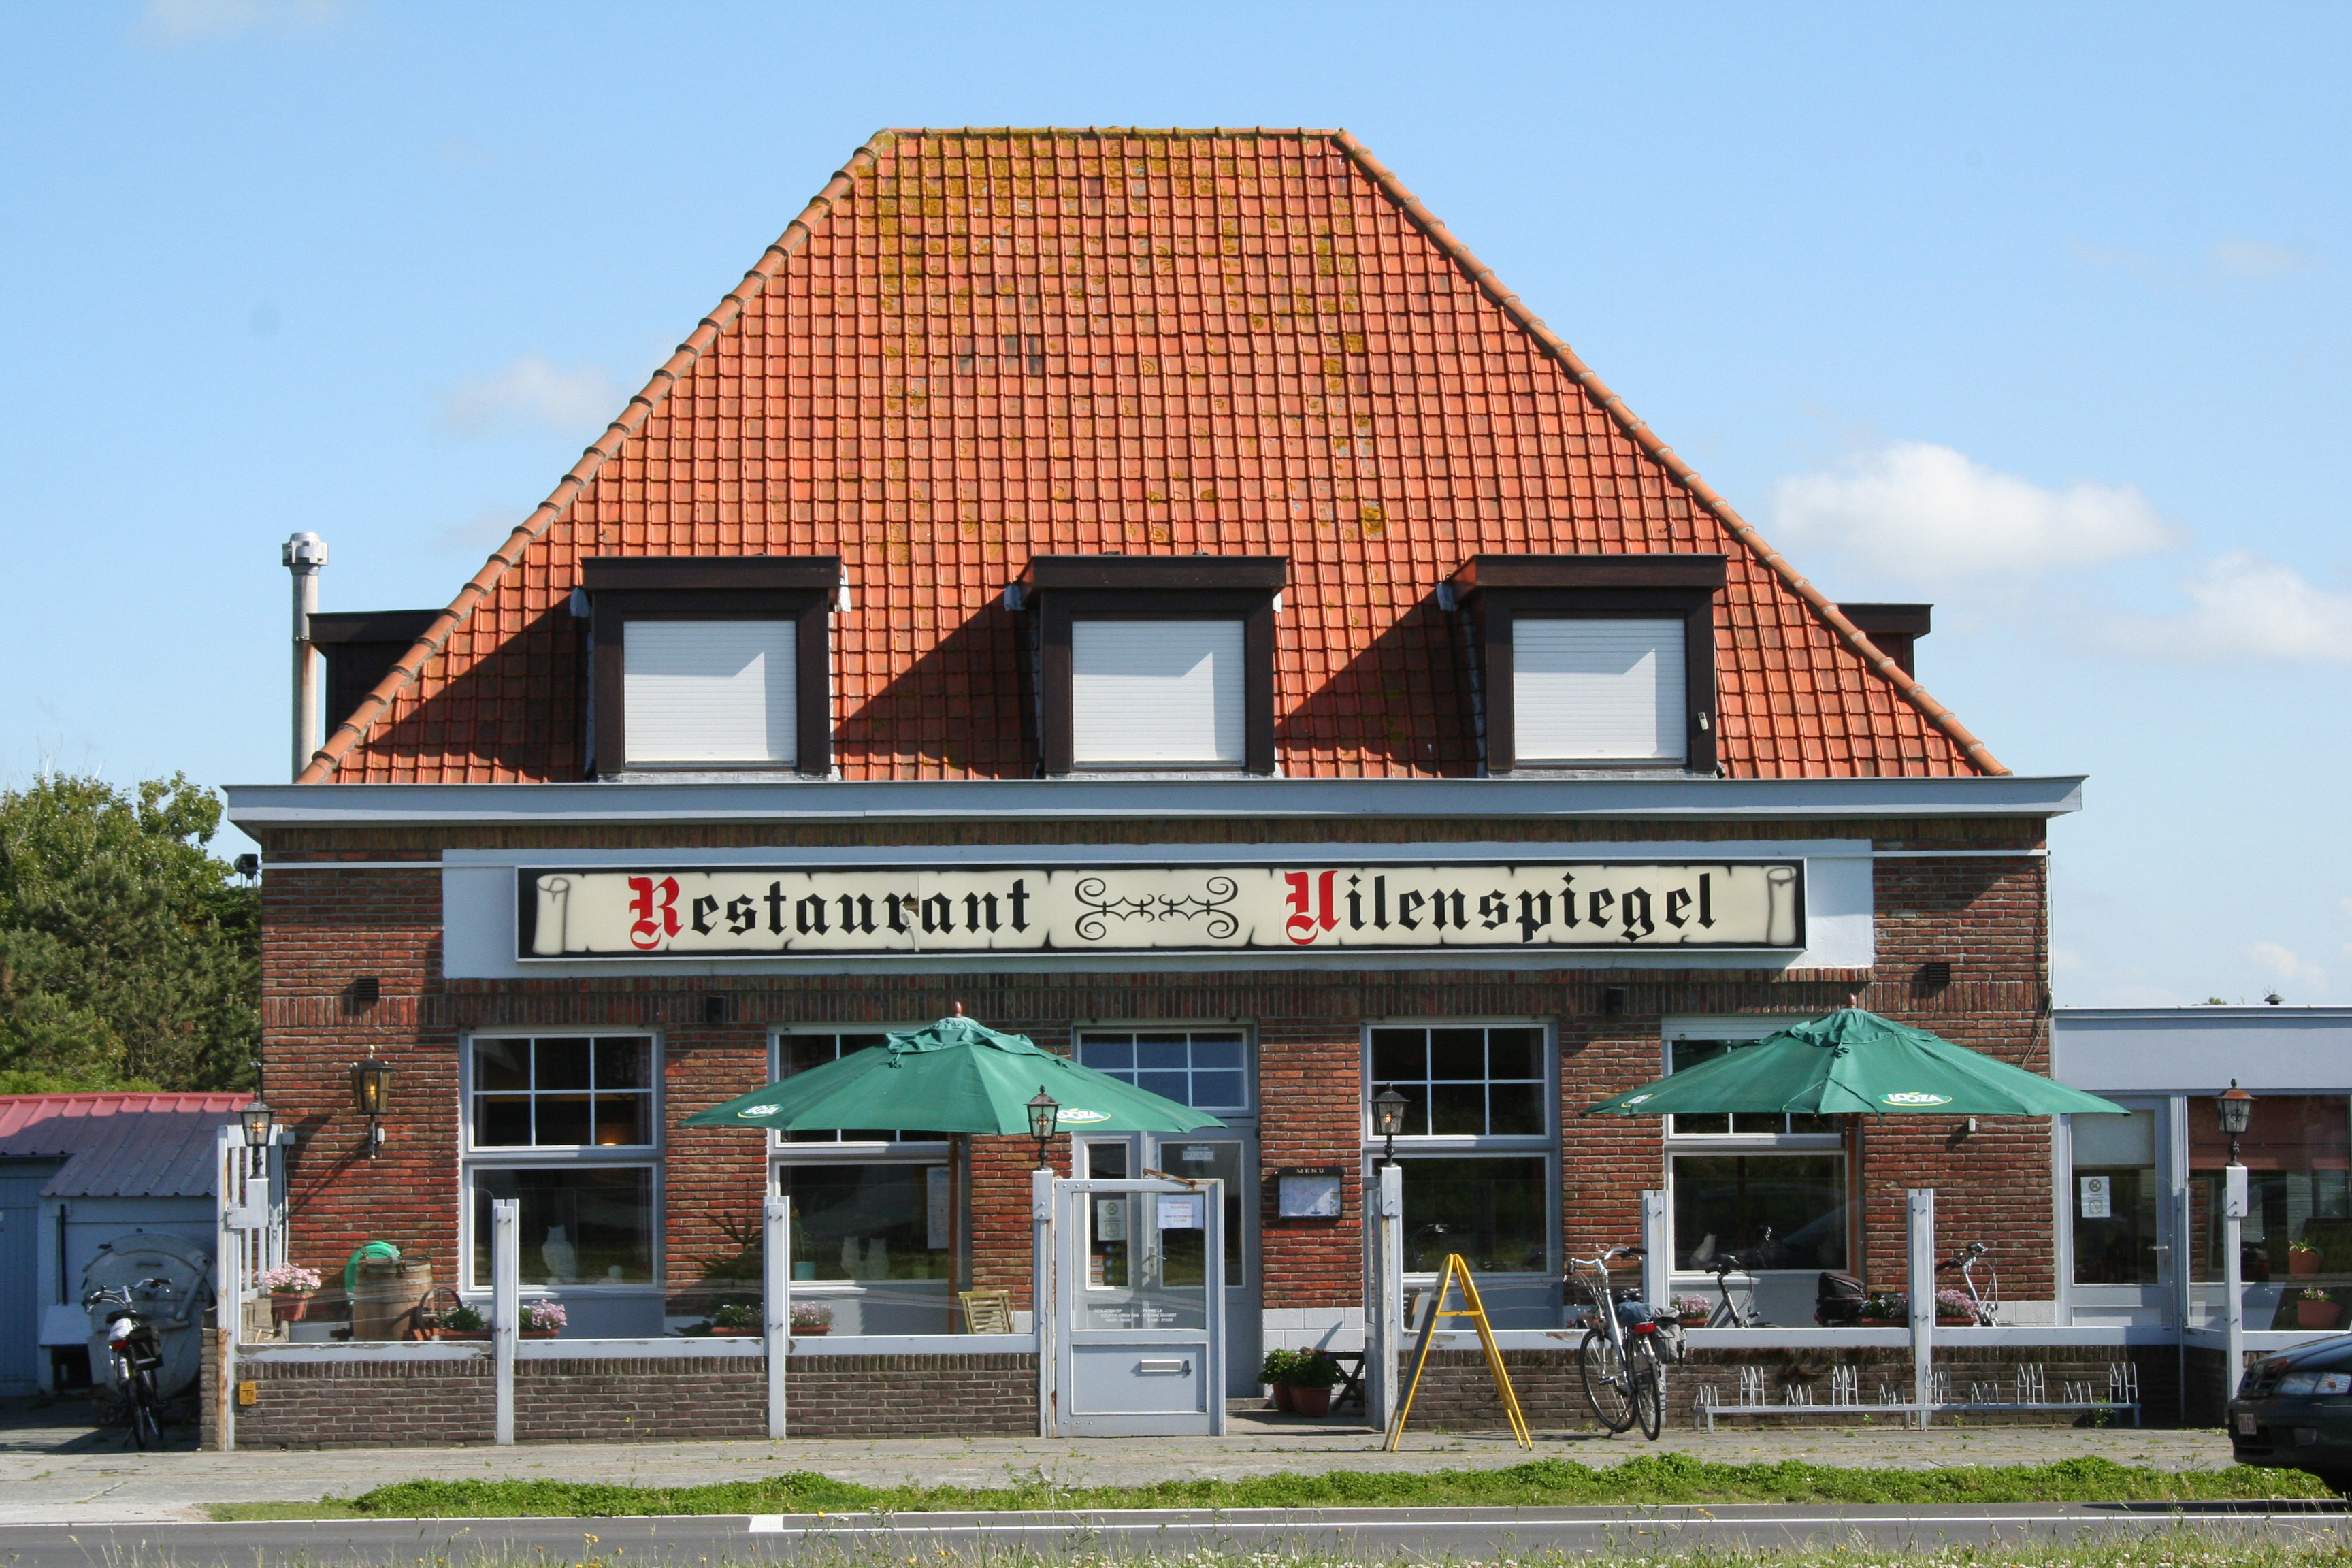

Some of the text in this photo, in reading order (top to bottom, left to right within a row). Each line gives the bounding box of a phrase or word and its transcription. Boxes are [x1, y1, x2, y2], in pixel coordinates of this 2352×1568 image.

[628, 870, 1717, 950] Restaurant Uilenspiegel
[1887, 1092, 1944, 1102] LOOZA
[1181, 1360, 1192, 1375] 4
